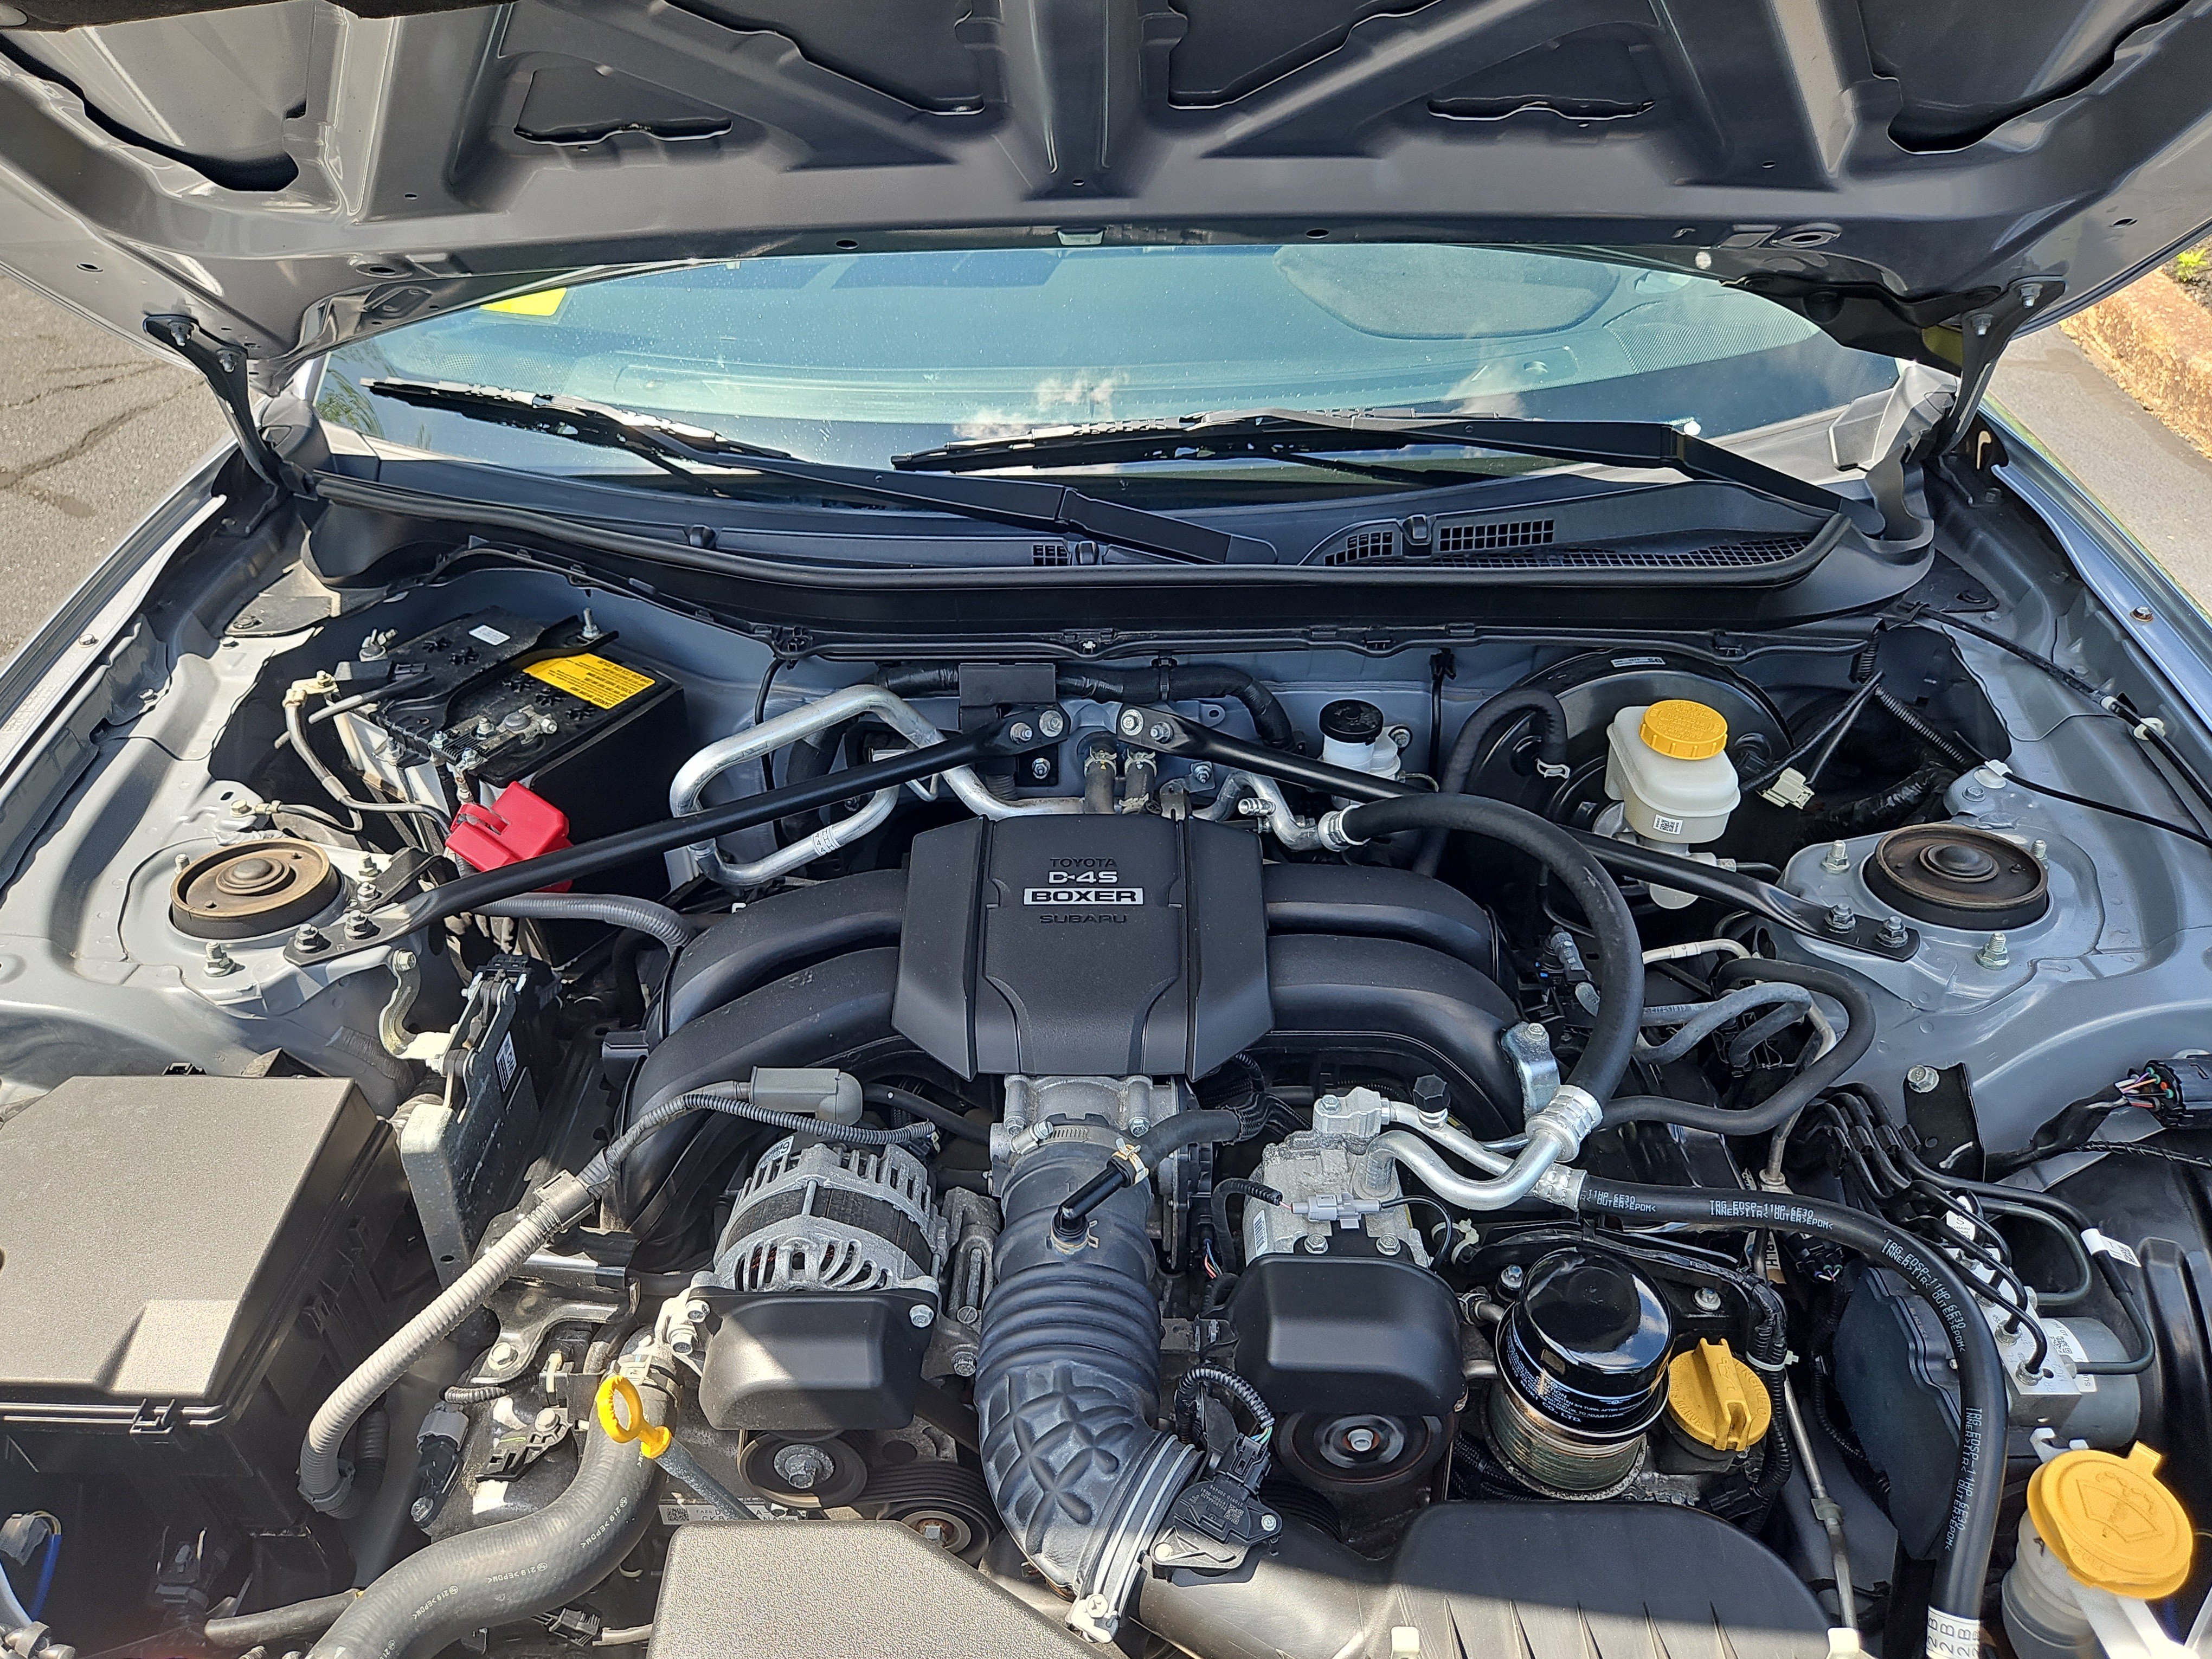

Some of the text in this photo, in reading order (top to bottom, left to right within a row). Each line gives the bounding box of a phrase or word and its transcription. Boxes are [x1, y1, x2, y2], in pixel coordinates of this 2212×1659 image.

[1050, 857, 1117, 867] TOYOTA
[1049, 871, 1118, 884] D-4S
[1031, 890, 1136, 902] BOXER
[1040, 914, 1128, 924] SUBARU
[1939, 1623, 1954, 1655] 2B
[1957, 1628, 1971, 1657] 2B
